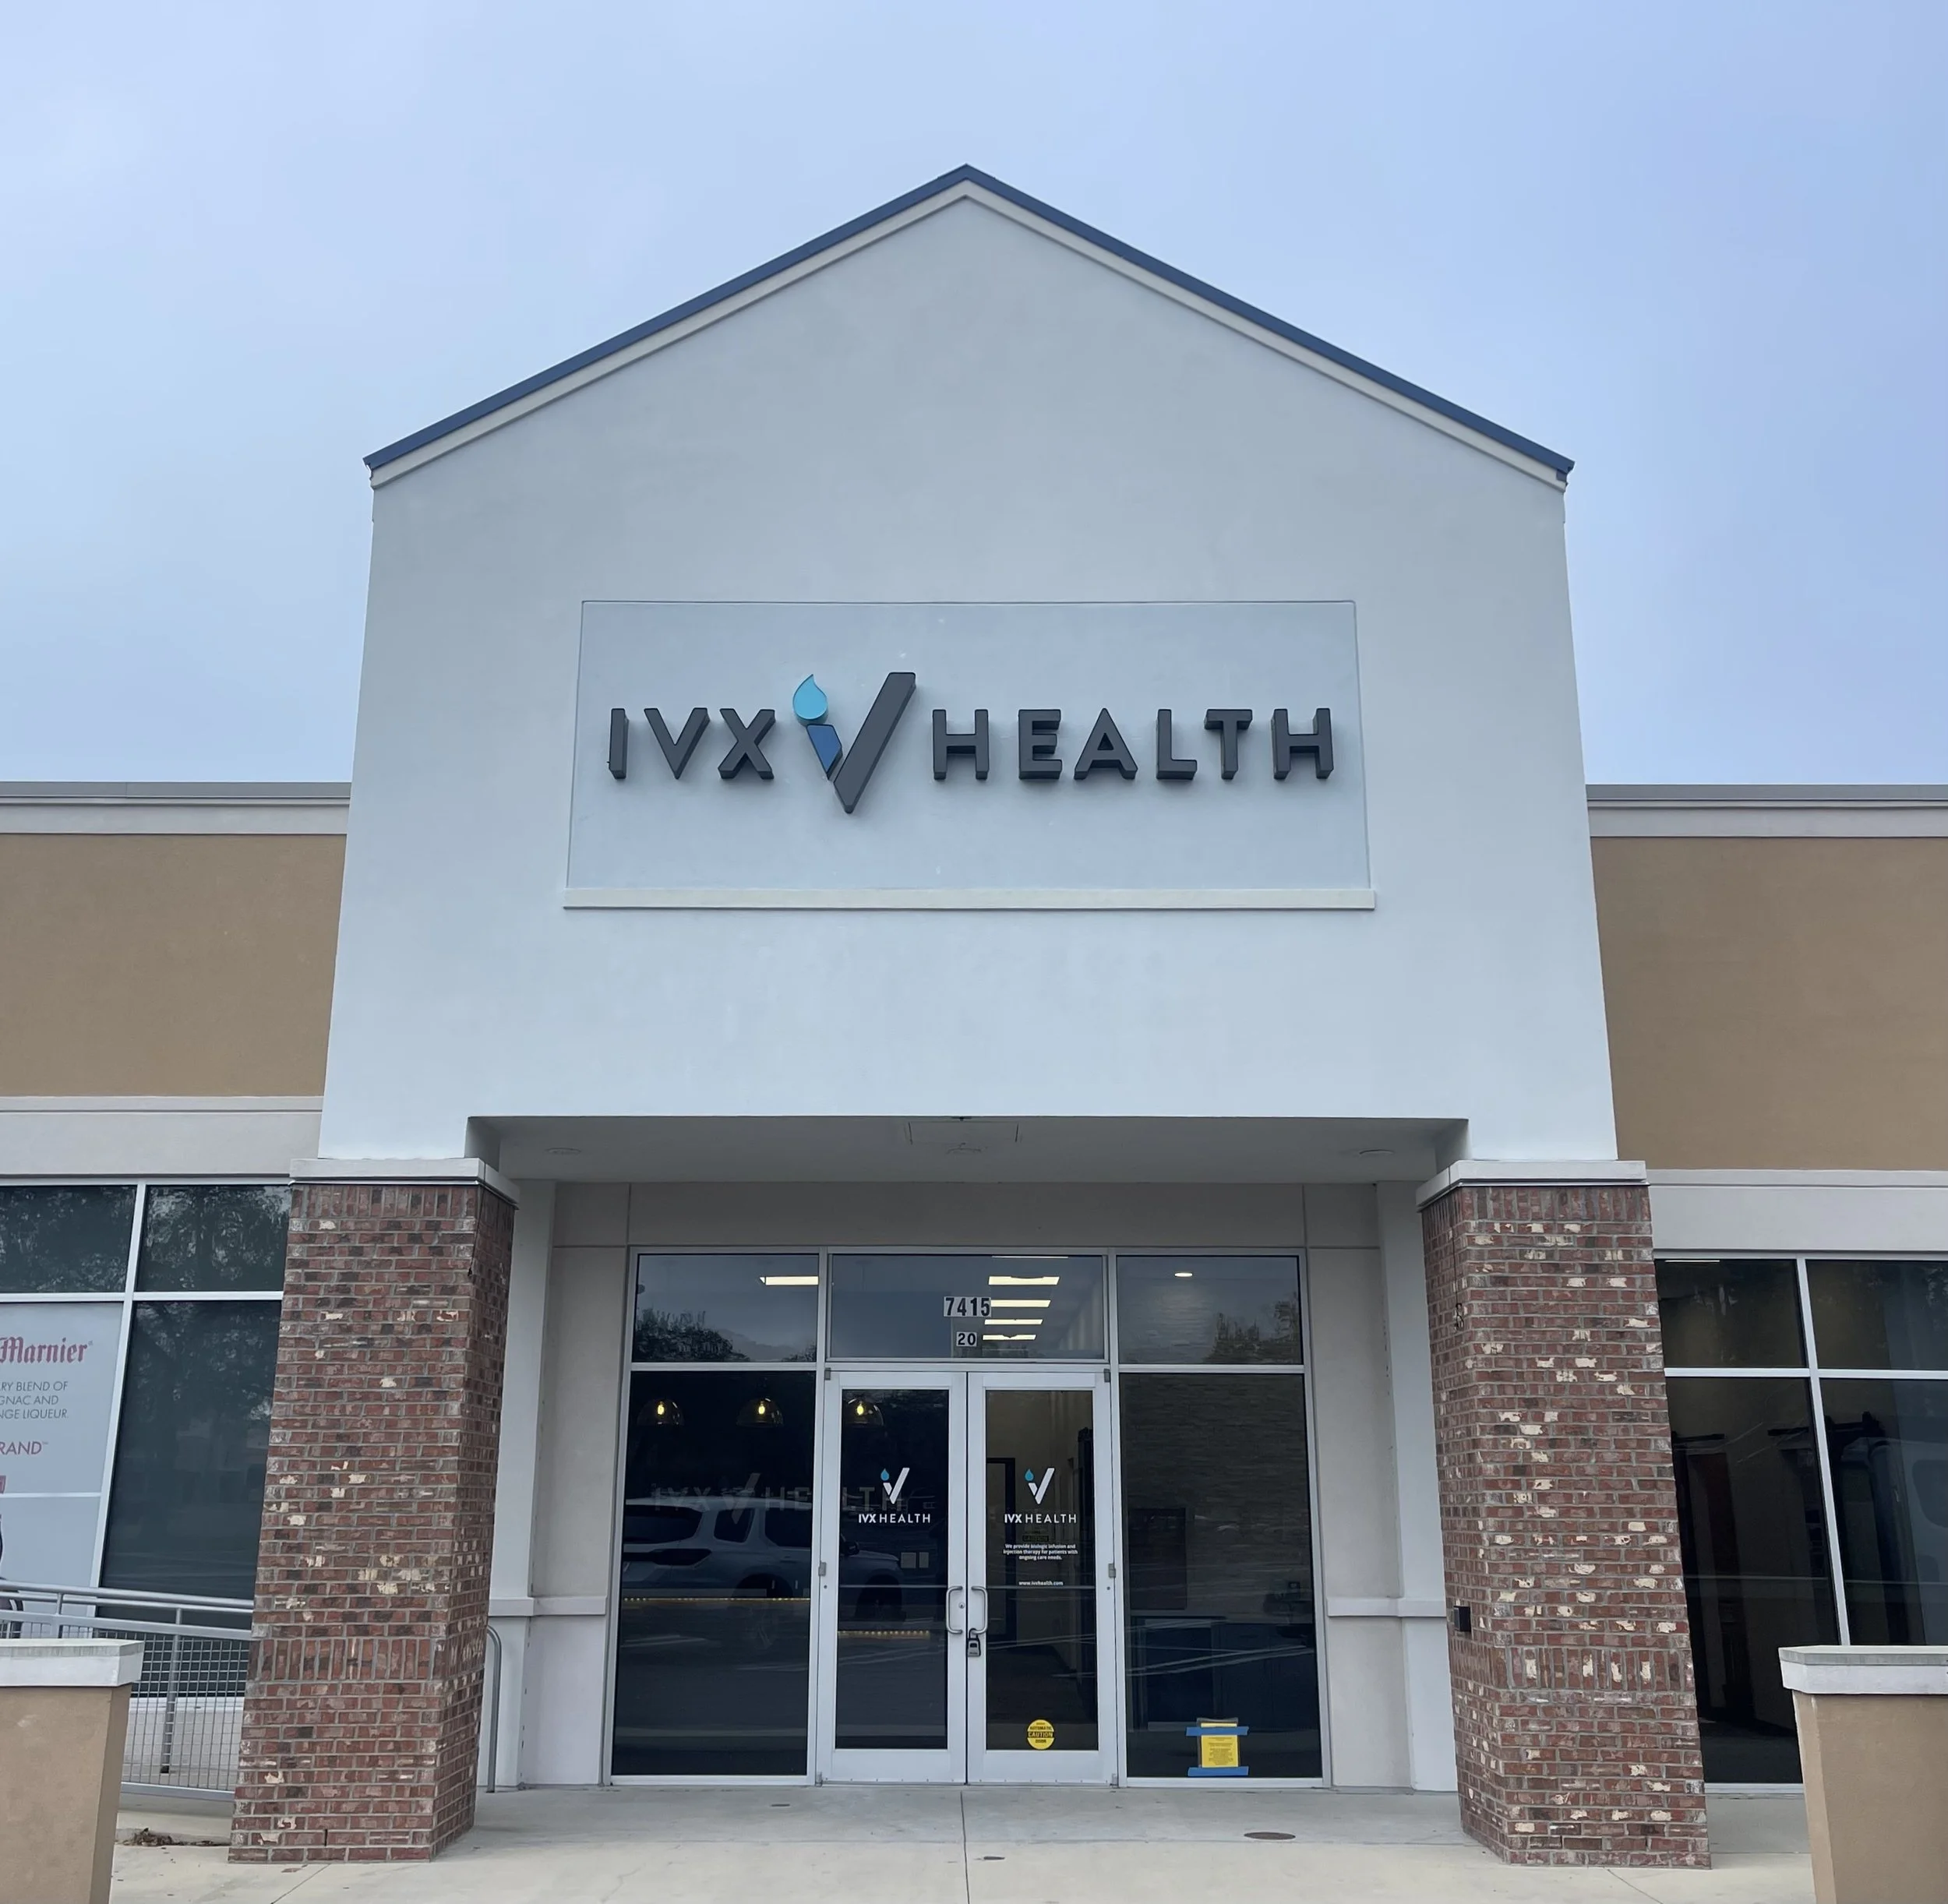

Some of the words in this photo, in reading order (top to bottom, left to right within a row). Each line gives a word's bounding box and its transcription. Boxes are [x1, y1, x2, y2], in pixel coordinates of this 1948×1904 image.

[609, 707, 775, 780] IVX
[932, 707, 1334, 781] HEALTH
[945, 1297, 990, 1317] 7415
[958, 1332, 976, 1345] 20
[0, 1381, 13, 1391] RY
[16, 1381, 50, 1391] BLEND
[53, 1380, 69, 1391] OF
[34, 1395, 59, 1405] AND
[858, 1514, 877, 1524] IVX
[879, 1514, 931, 1524] HEALTH
[1004, 1514, 1022, 1524] IVX
[1025, 1514, 1077, 1524] HEALTH
